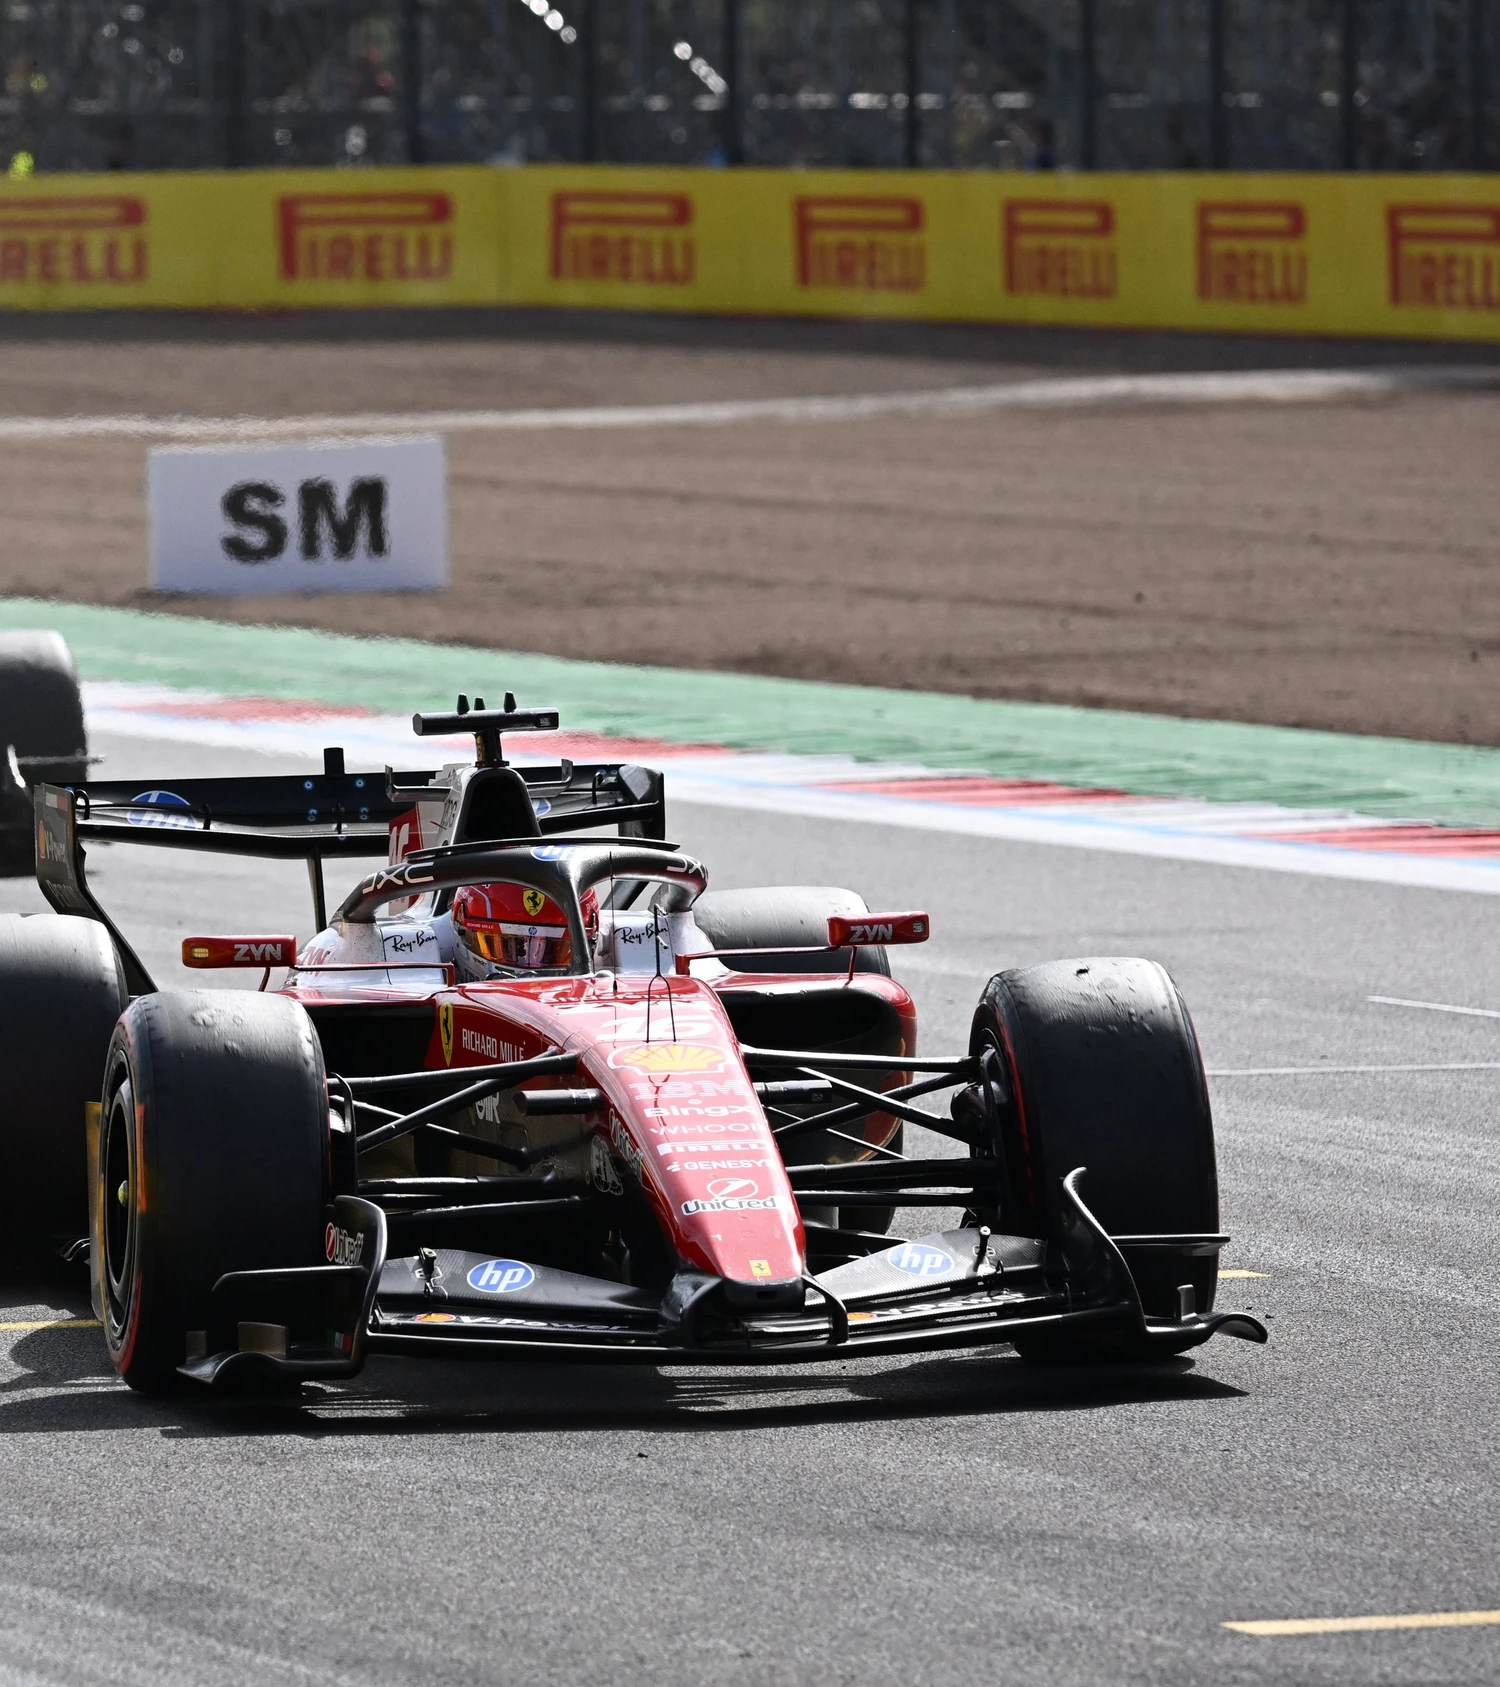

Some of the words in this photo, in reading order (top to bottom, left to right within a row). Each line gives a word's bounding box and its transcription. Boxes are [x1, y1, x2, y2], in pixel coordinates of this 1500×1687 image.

[277, 191, 454, 280] PIRELLI
[550, 190, 694, 282] PIRELLI
[794, 195, 926, 290] PIRELLI
[1003, 198, 1116, 297] PIRELLI
[1197, 200, 1307, 304] PIRELLI
[1386, 202, 1500, 309] PIRELL
[221, 476, 389, 564] SM
[384, 930, 438, 953] Ray-Ban
[850, 924, 893, 943] ZYN
[233, 943, 282, 962] ZYN
[462, 1028, 498, 1059] RICHARD
[499, 1041, 525, 1062] MILLE
[596, 1015, 713, 1041] 16
[628, 1079, 751, 1100] IBM
[656, 1138, 777, 1156] PIRELL
[477, 1259, 524, 1293] hp
[899, 1244, 943, 1275] hp
[459, 1314, 630, 1331] V-Power
